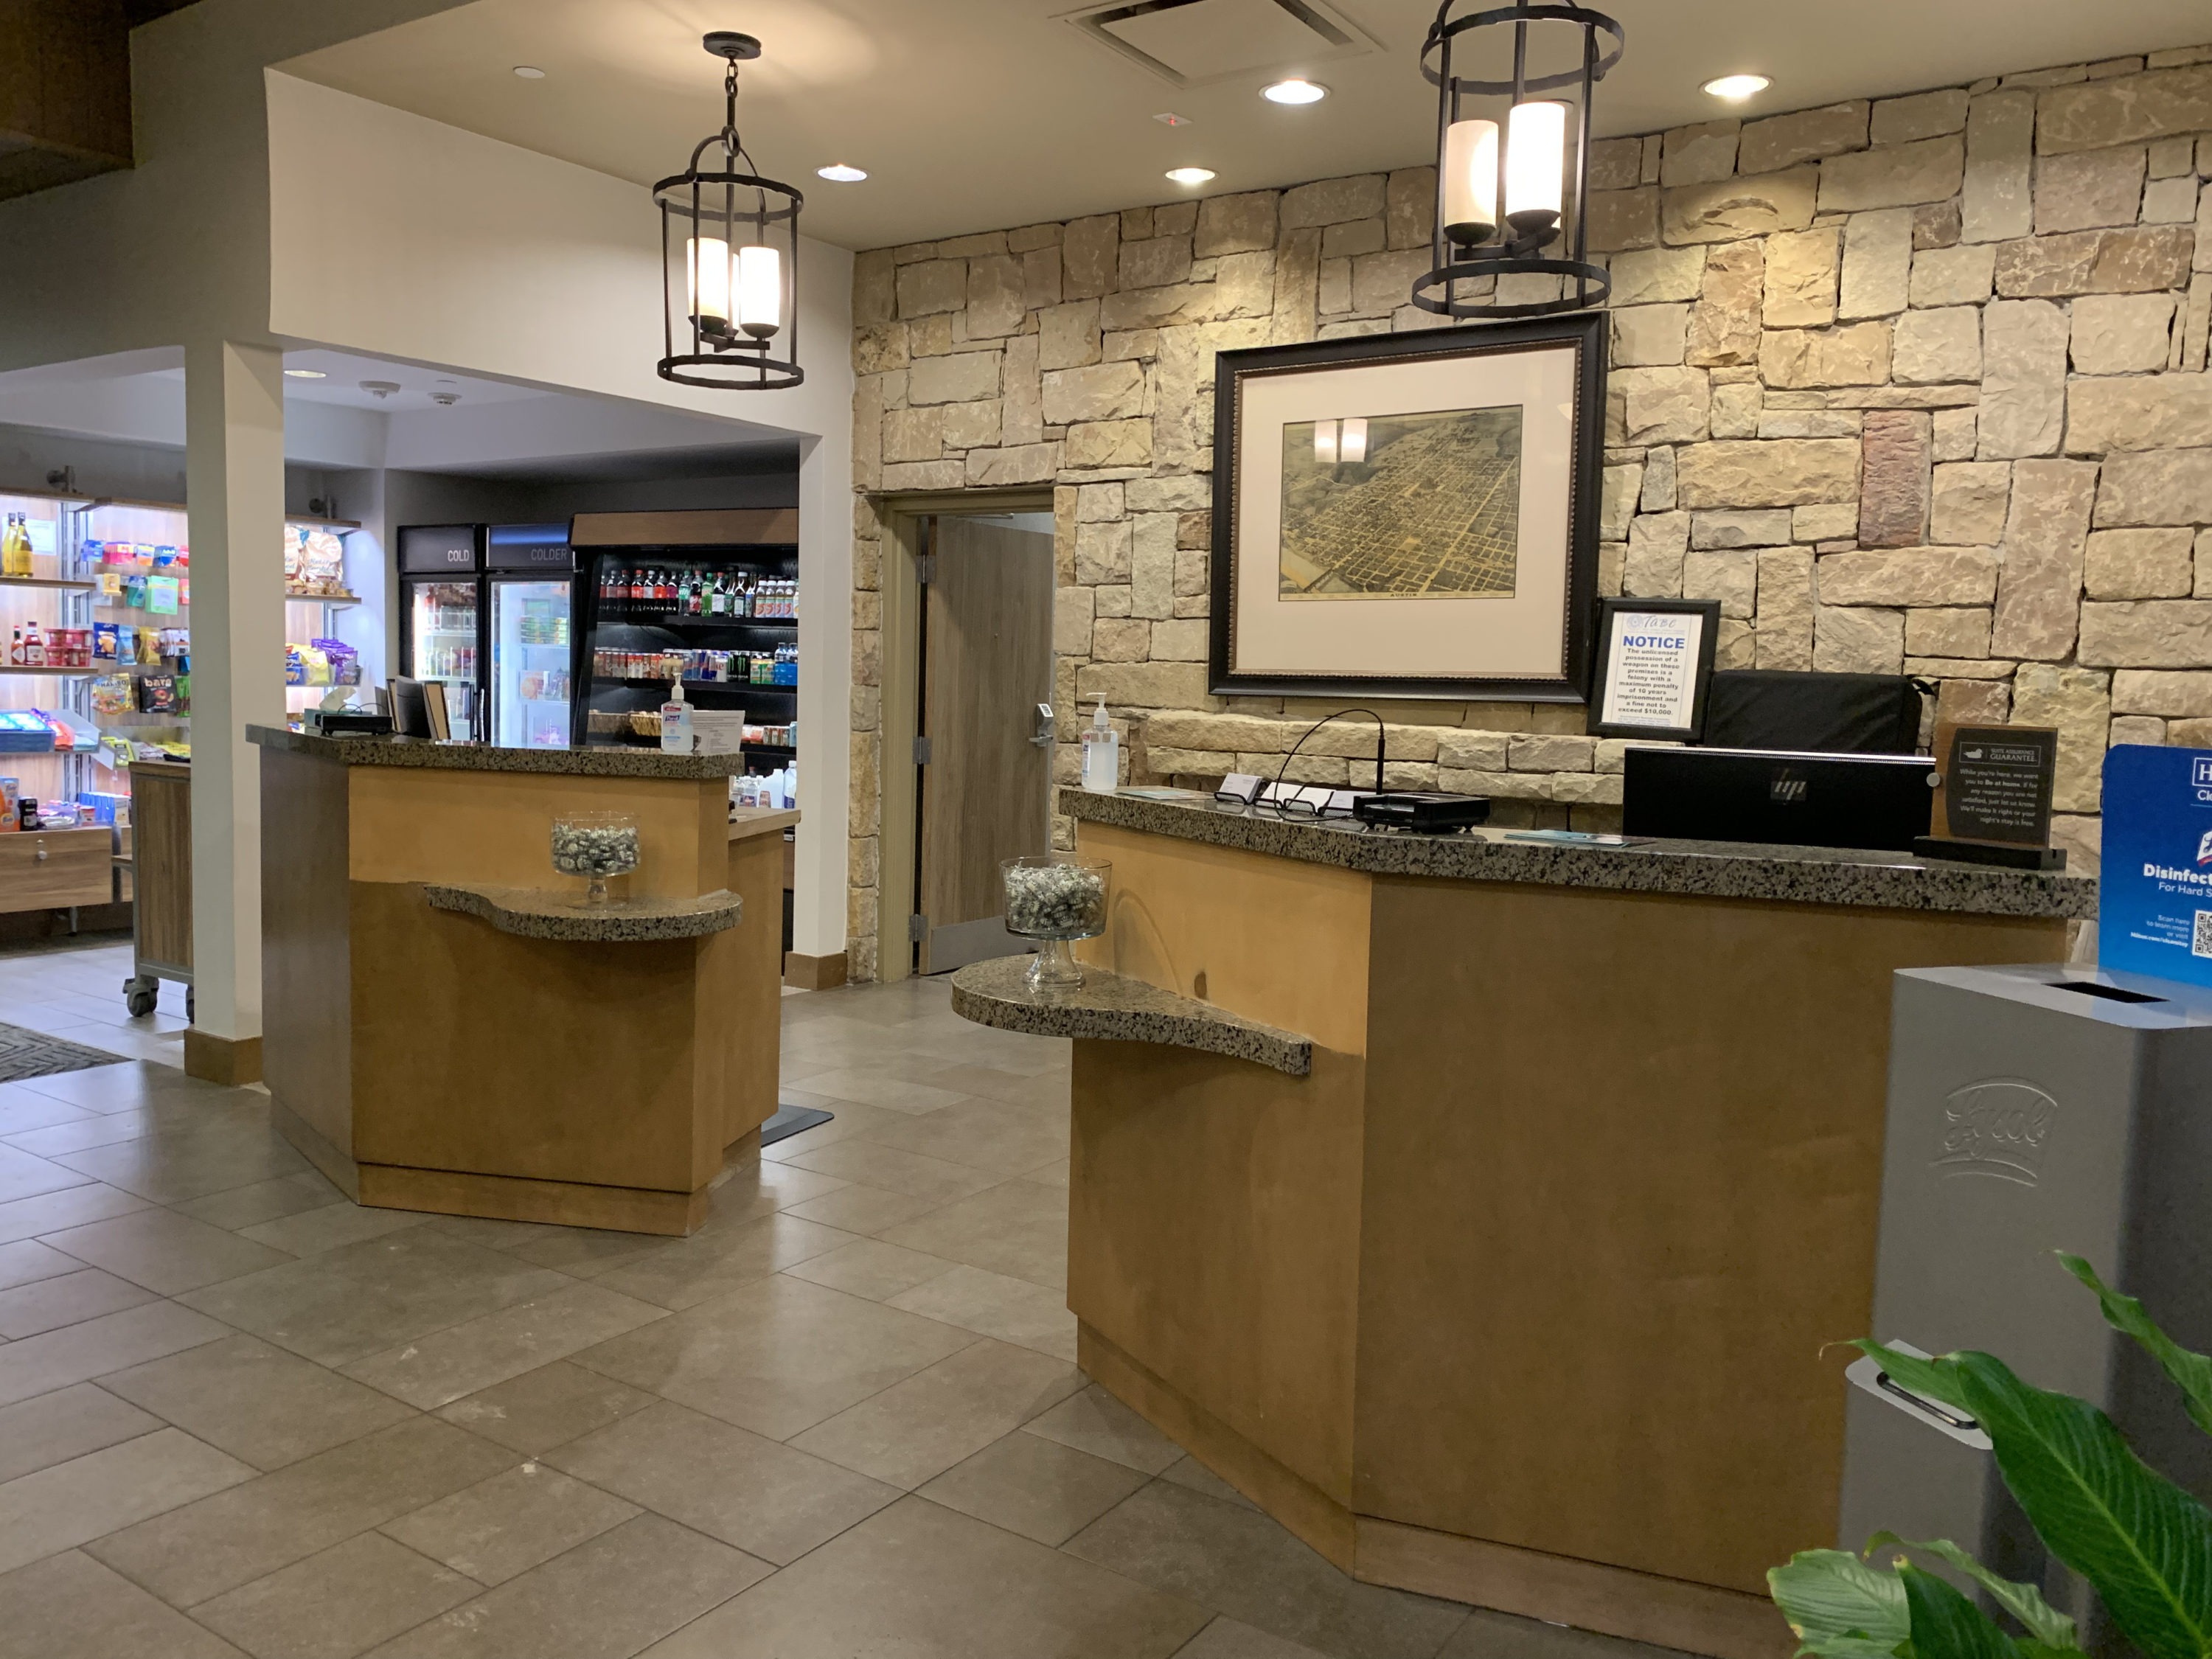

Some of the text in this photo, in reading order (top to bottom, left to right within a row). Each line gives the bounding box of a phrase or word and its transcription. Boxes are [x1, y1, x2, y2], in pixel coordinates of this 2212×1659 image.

[448, 549, 470, 562] COLD
[531, 548, 567, 561] COLDER
[1623, 636, 1686, 649] NOTICE
[144, 678, 172, 687] bare
[2159, 881, 2175, 891] For
[2177, 884, 2203, 897] Hard
